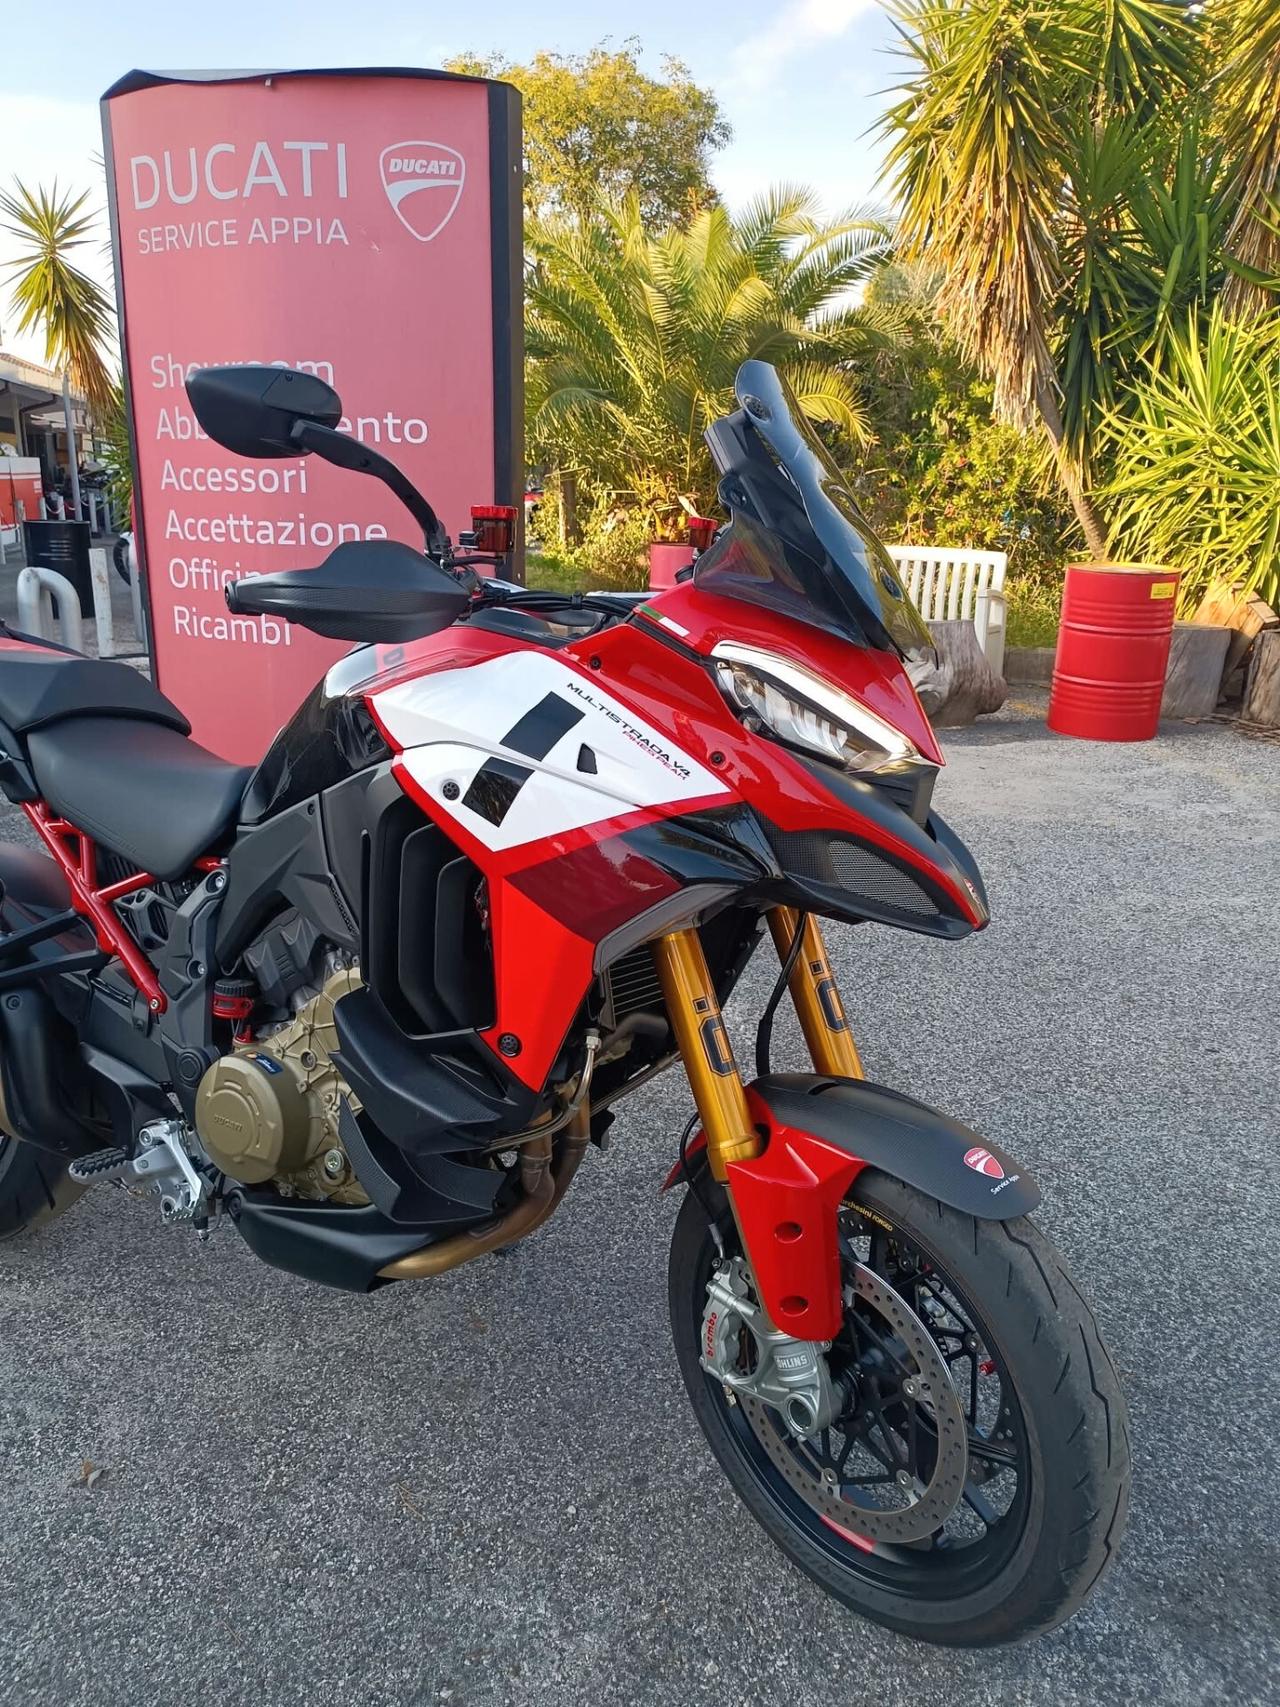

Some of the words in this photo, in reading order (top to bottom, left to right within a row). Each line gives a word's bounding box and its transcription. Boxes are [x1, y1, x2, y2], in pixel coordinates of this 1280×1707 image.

[131, 142, 348, 210] DUCATI
[389, 158, 456, 176] DUCATI
[138, 219, 238, 254] SERVICE
[248, 217, 349, 246] APPIA
[161, 460, 307, 493] Accessori
[165, 509, 388, 545] Accettazione
[169, 557, 262, 591] Offici
[173, 605, 291, 646] Ricambi
[567, 682, 670, 762] MULTISTRADA
[673, 761, 691, 777] V4
[706, 1312, 718, 1357] brembo
